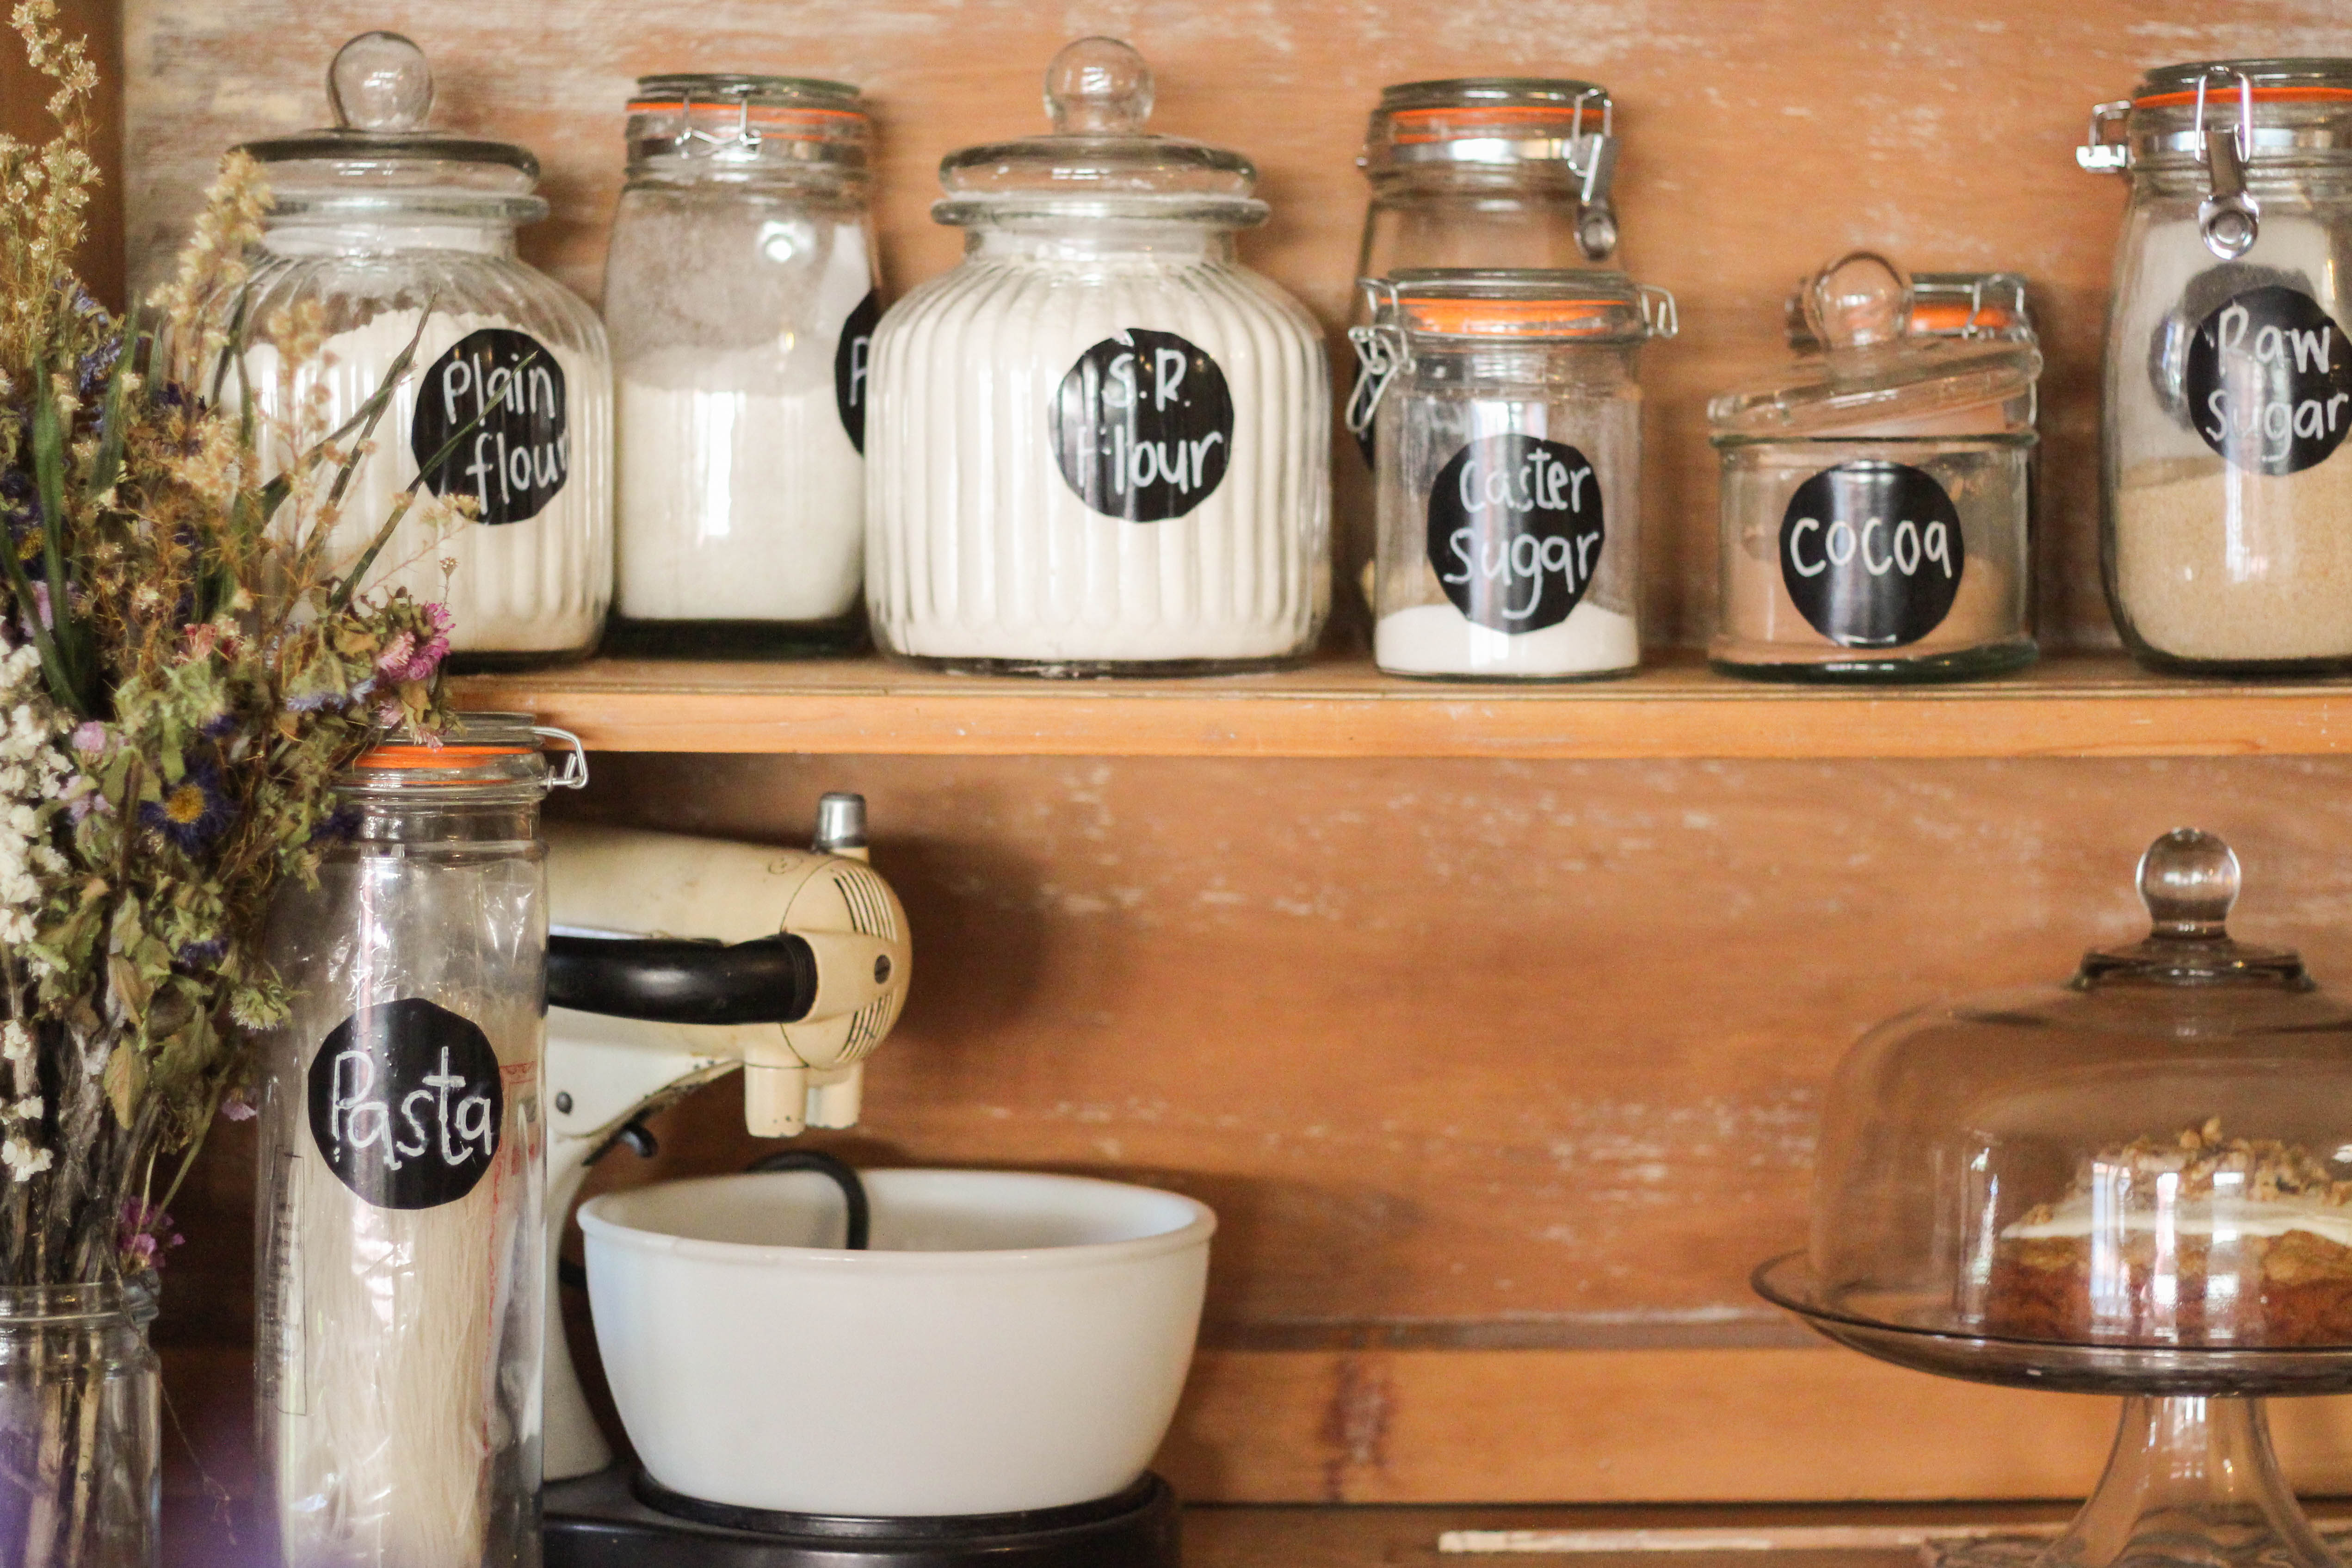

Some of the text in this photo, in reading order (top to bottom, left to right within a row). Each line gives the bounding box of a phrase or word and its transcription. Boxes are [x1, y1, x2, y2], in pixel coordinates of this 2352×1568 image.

[1102, 348, 1191, 412] S.R.
[1459, 448, 1591, 513] Caster
[331, 1046, 492, 1170] Pasta
